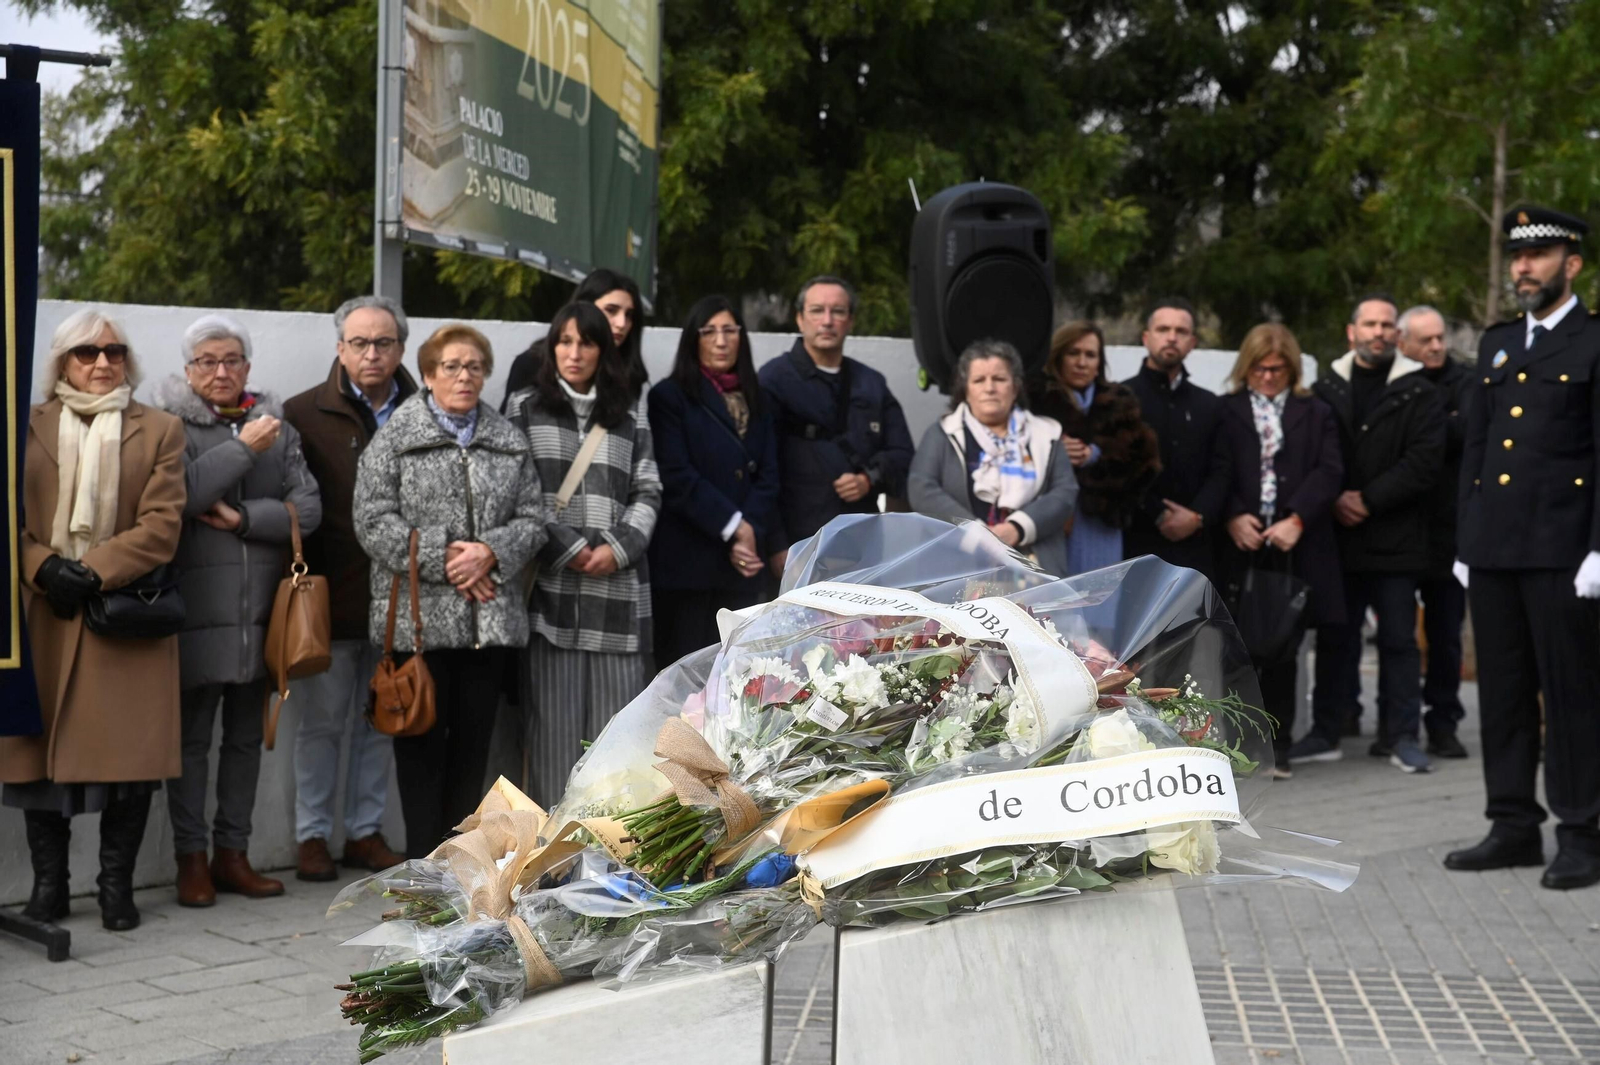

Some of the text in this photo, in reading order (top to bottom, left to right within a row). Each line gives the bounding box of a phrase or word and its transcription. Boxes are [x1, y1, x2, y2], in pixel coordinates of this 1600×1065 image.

[514, 0, 592, 127] 2025
[459, 96, 504, 137] PALACIO
[462, 132, 530, 181] DE LA MERCED
[501, 177, 558, 224] NOVIEMBRE
[809, 589, 898, 606] RECUERDO
[978, 763, 1226, 822] de Cordoba
